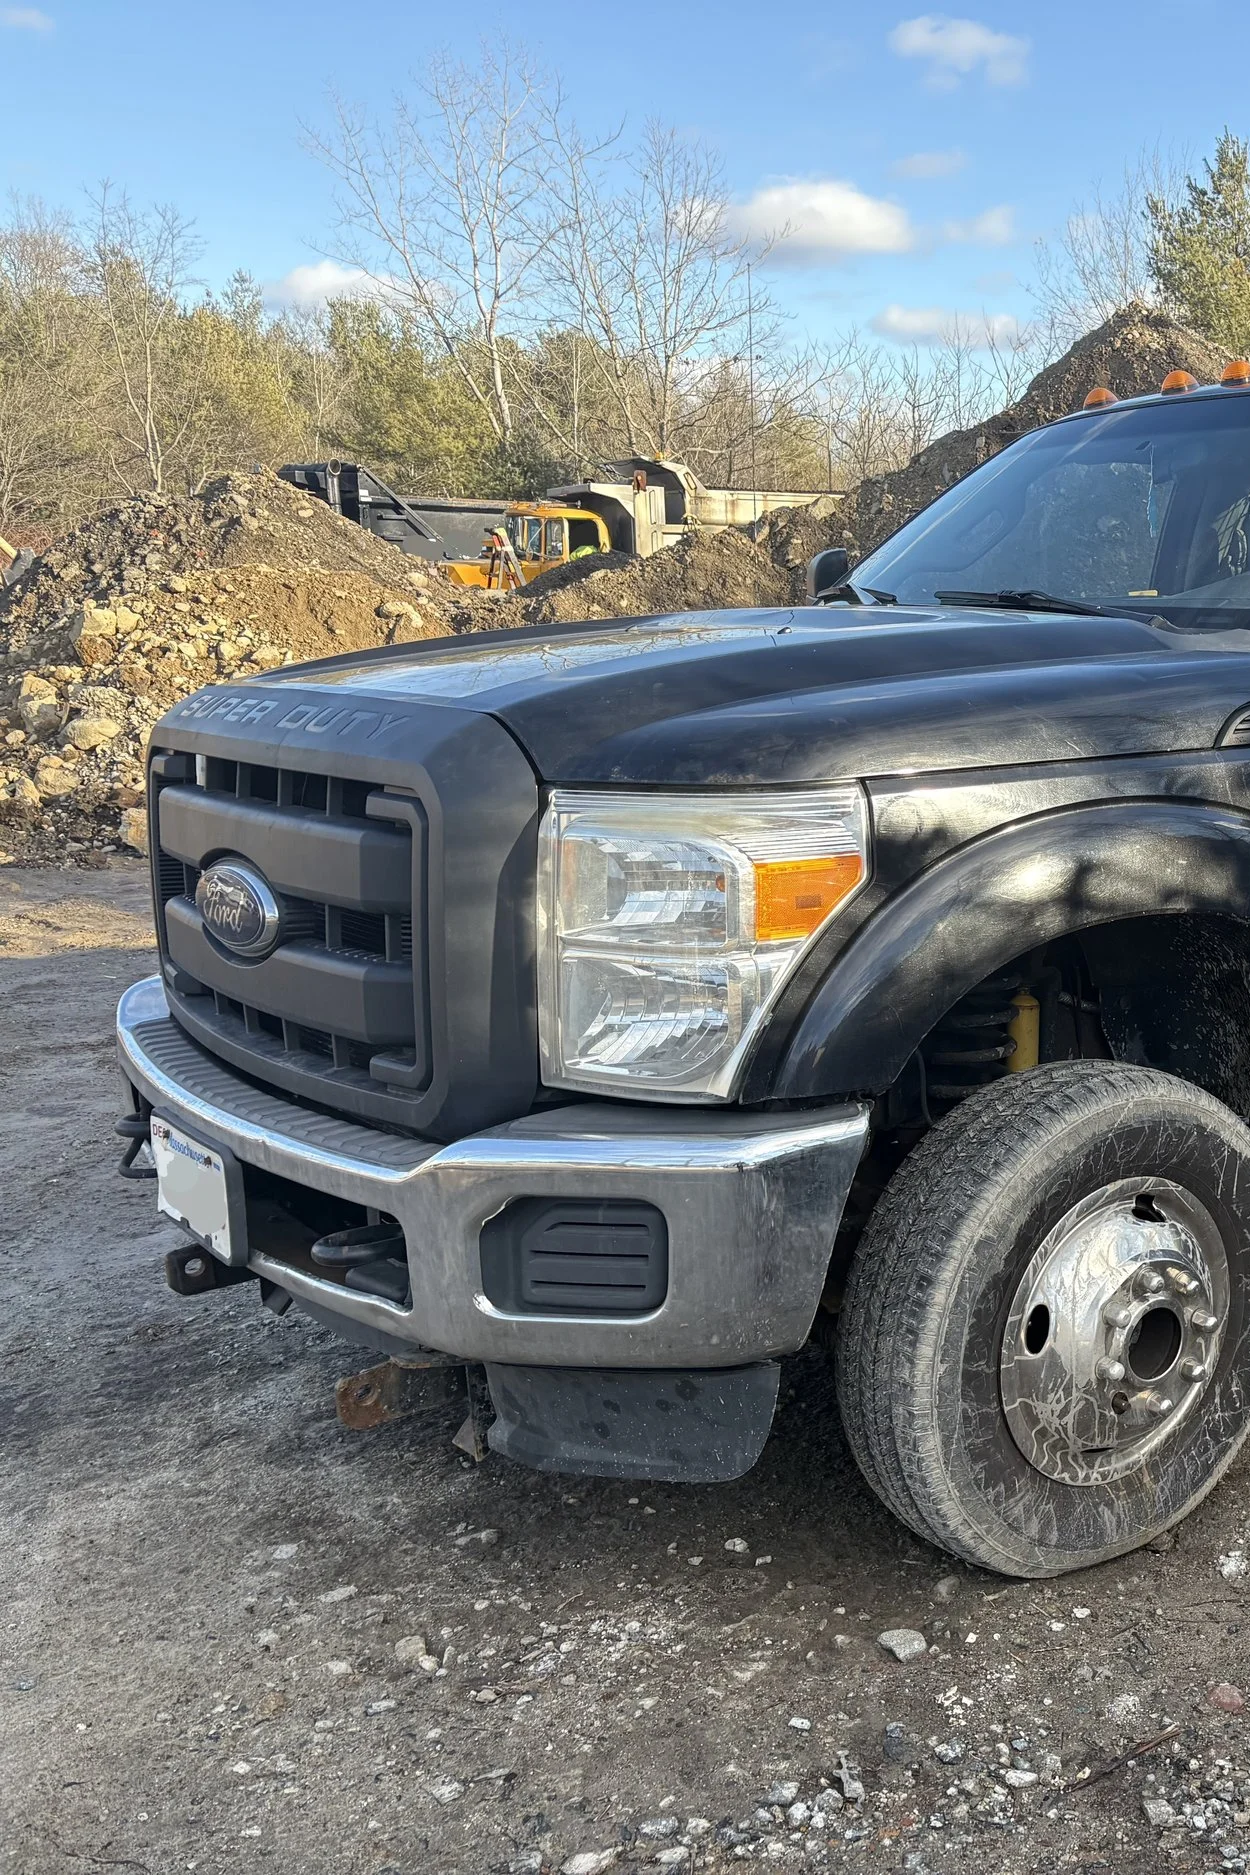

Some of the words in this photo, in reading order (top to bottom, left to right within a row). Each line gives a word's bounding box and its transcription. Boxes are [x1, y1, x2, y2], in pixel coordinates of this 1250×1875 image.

[181, 695, 278, 724] SUPER
[273, 702, 411, 740] DUTY
[203, 878, 243, 933] Ford
[168, 1131, 207, 1165] Massachusett
